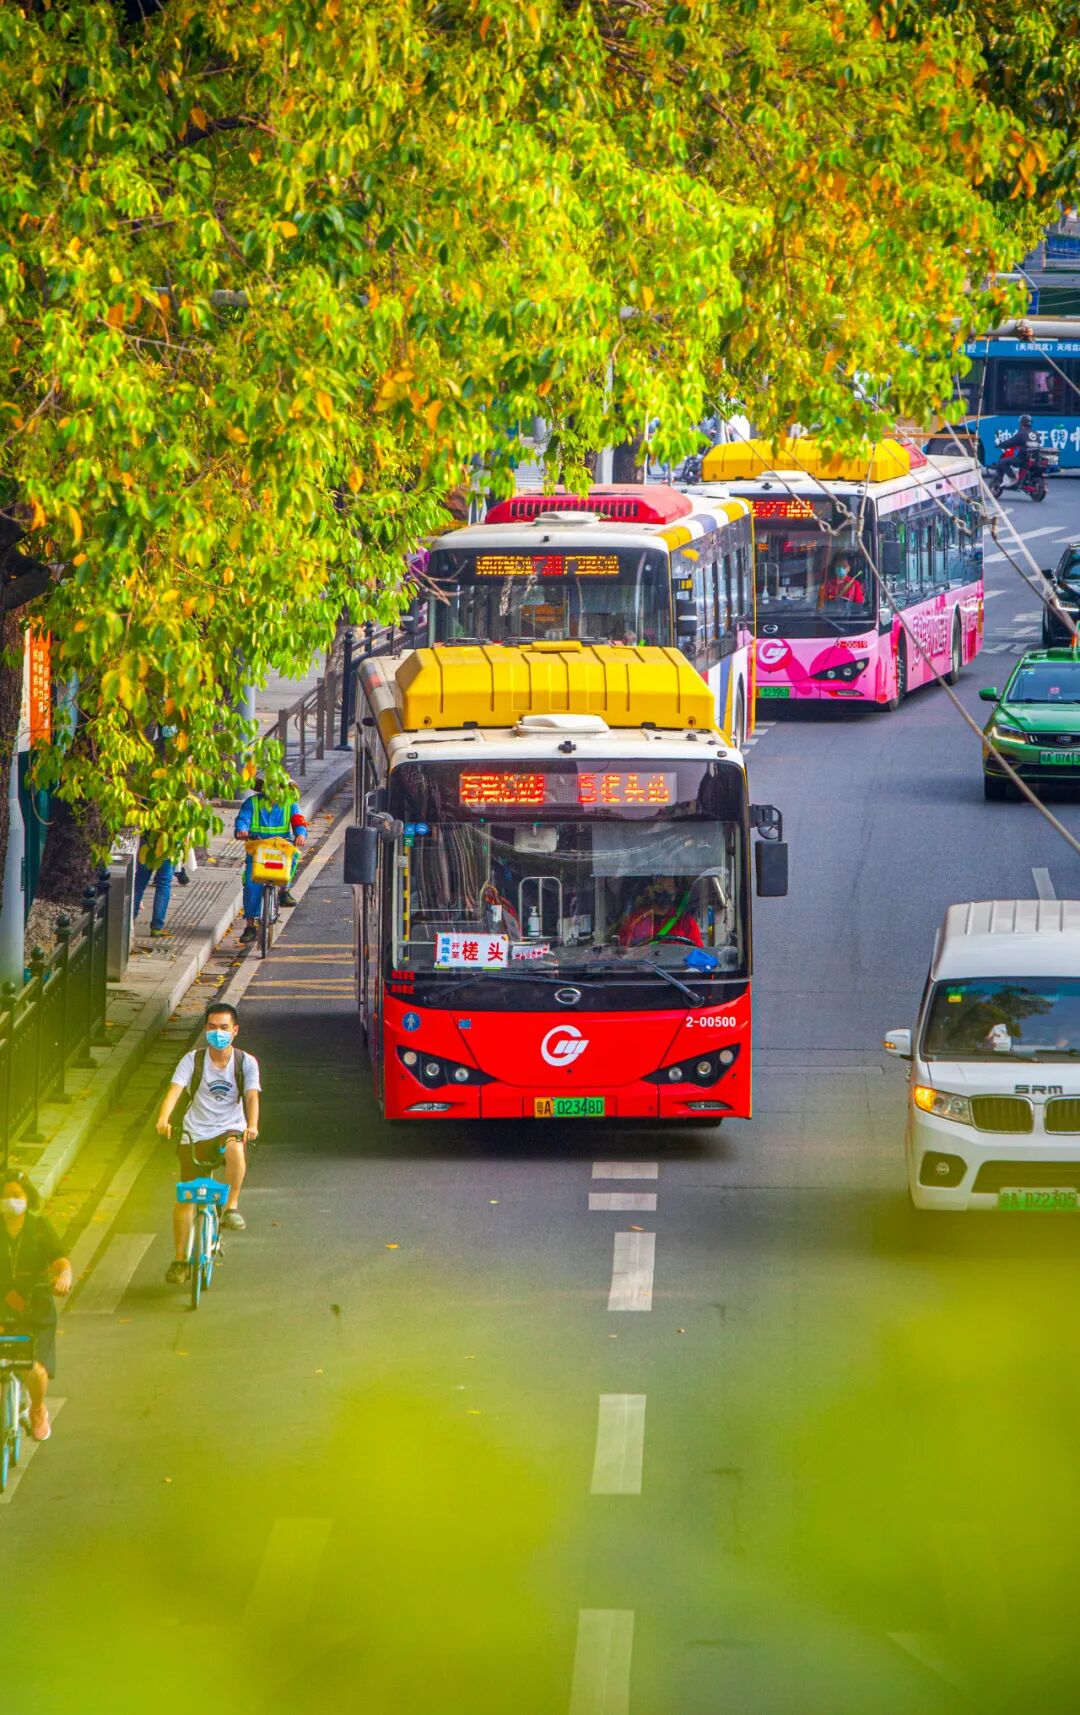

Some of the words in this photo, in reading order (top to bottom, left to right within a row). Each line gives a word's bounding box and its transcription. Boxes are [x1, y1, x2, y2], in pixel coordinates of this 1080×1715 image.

[462, 940, 504, 962] 槎头
[685, 1016, 737, 1028] 2-00500
[1014, 1084, 1064, 1095] SRM
